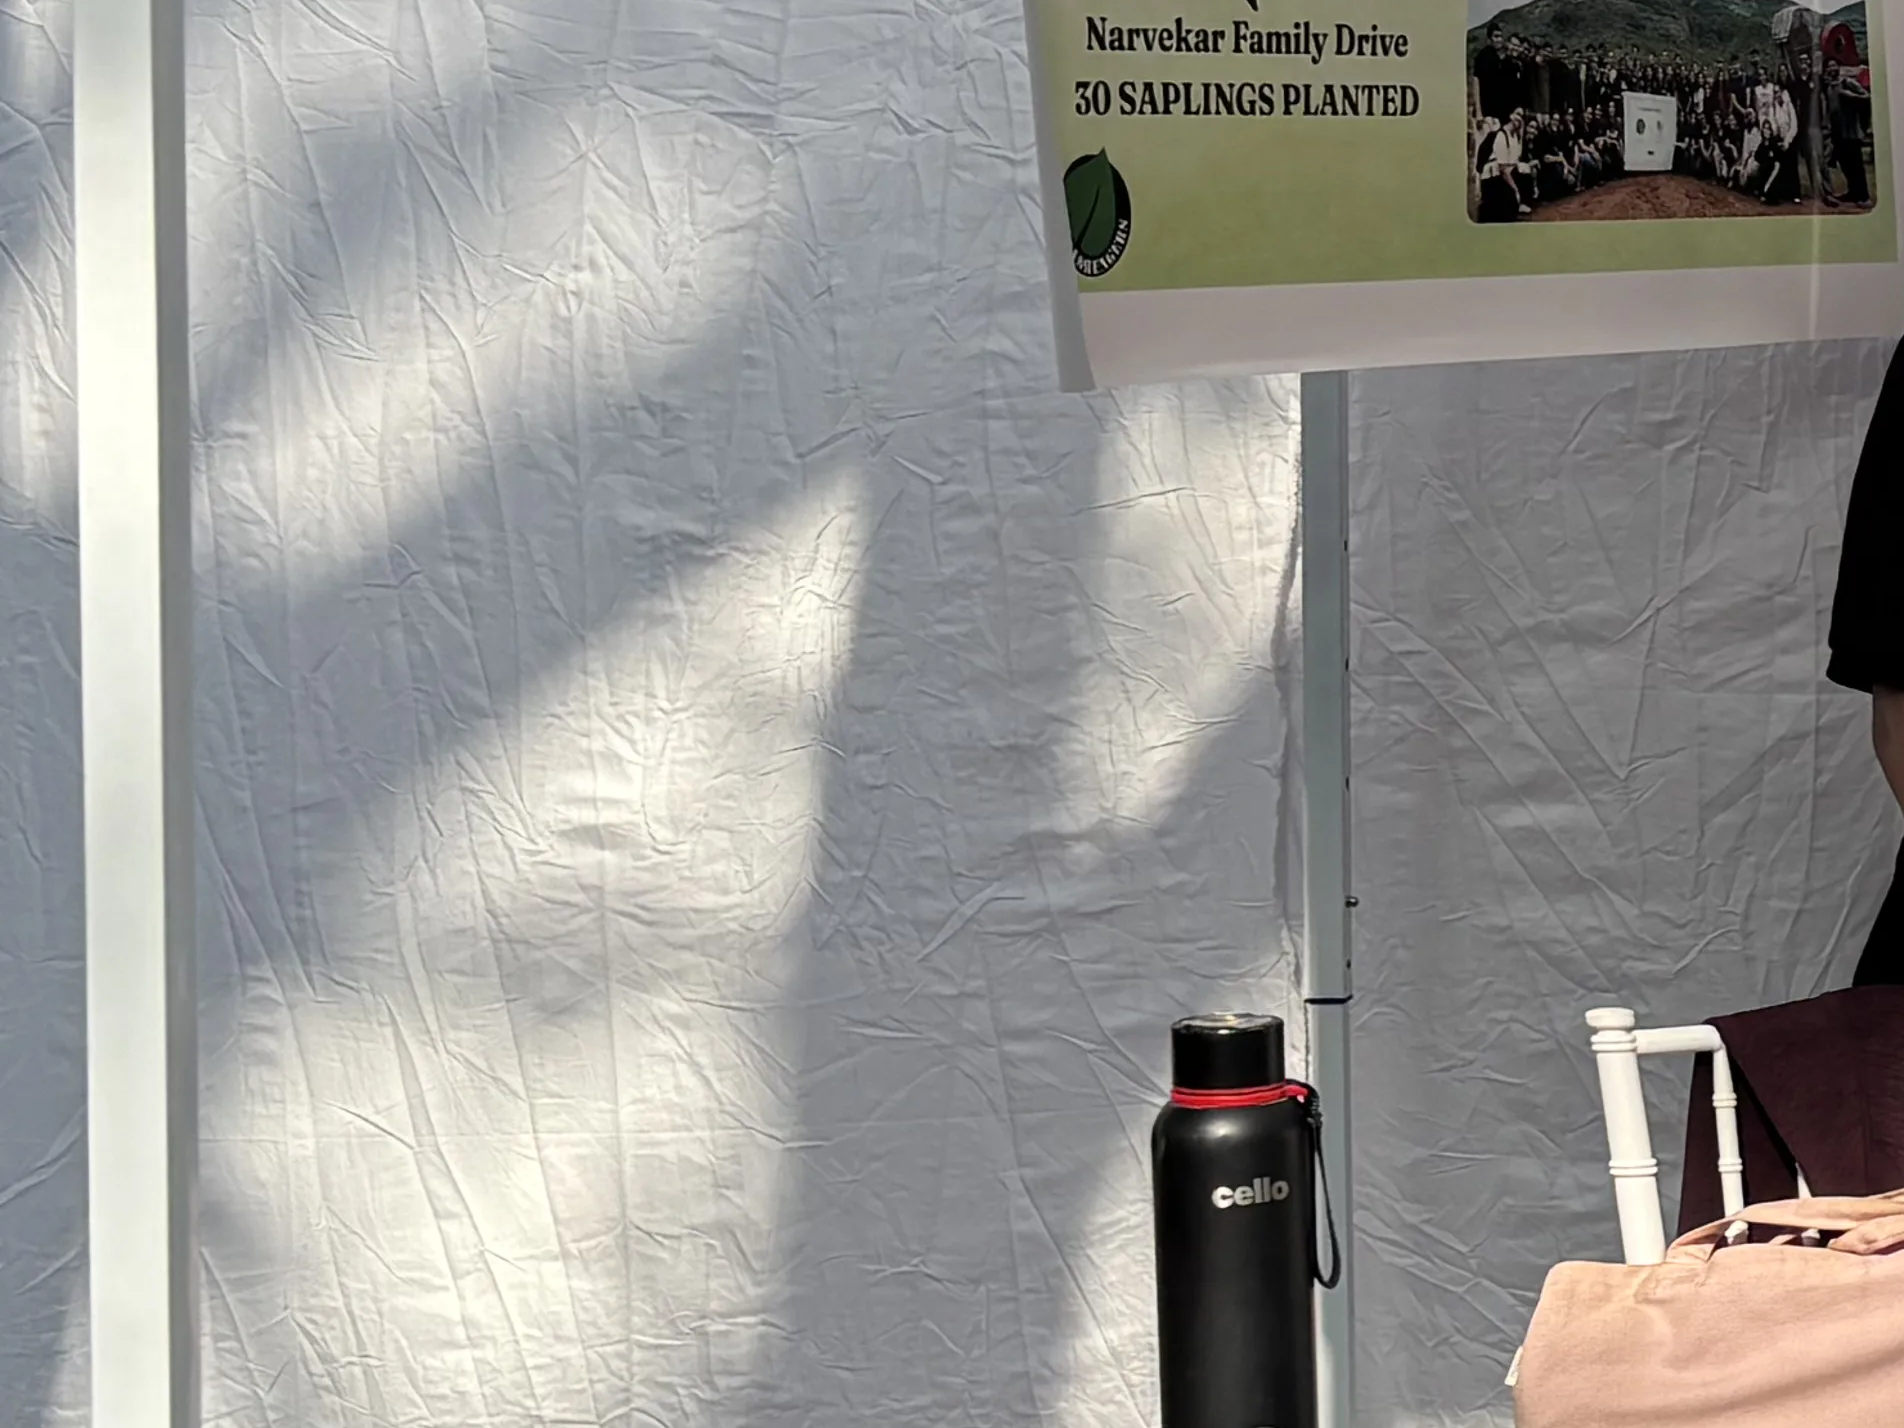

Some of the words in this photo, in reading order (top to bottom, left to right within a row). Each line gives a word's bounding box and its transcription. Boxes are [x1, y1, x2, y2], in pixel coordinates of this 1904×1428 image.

[1086, 16, 1225, 53] Narvekar
[1232, 20, 1328, 65] Family
[1335, 24, 1408, 57] Drive
[1075, 80, 1111, 116] 30
[1119, 81, 1275, 116] SAPLINGS
[1283, 84, 1420, 117] PLANTED
[1211, 1176, 1290, 1210] cello
